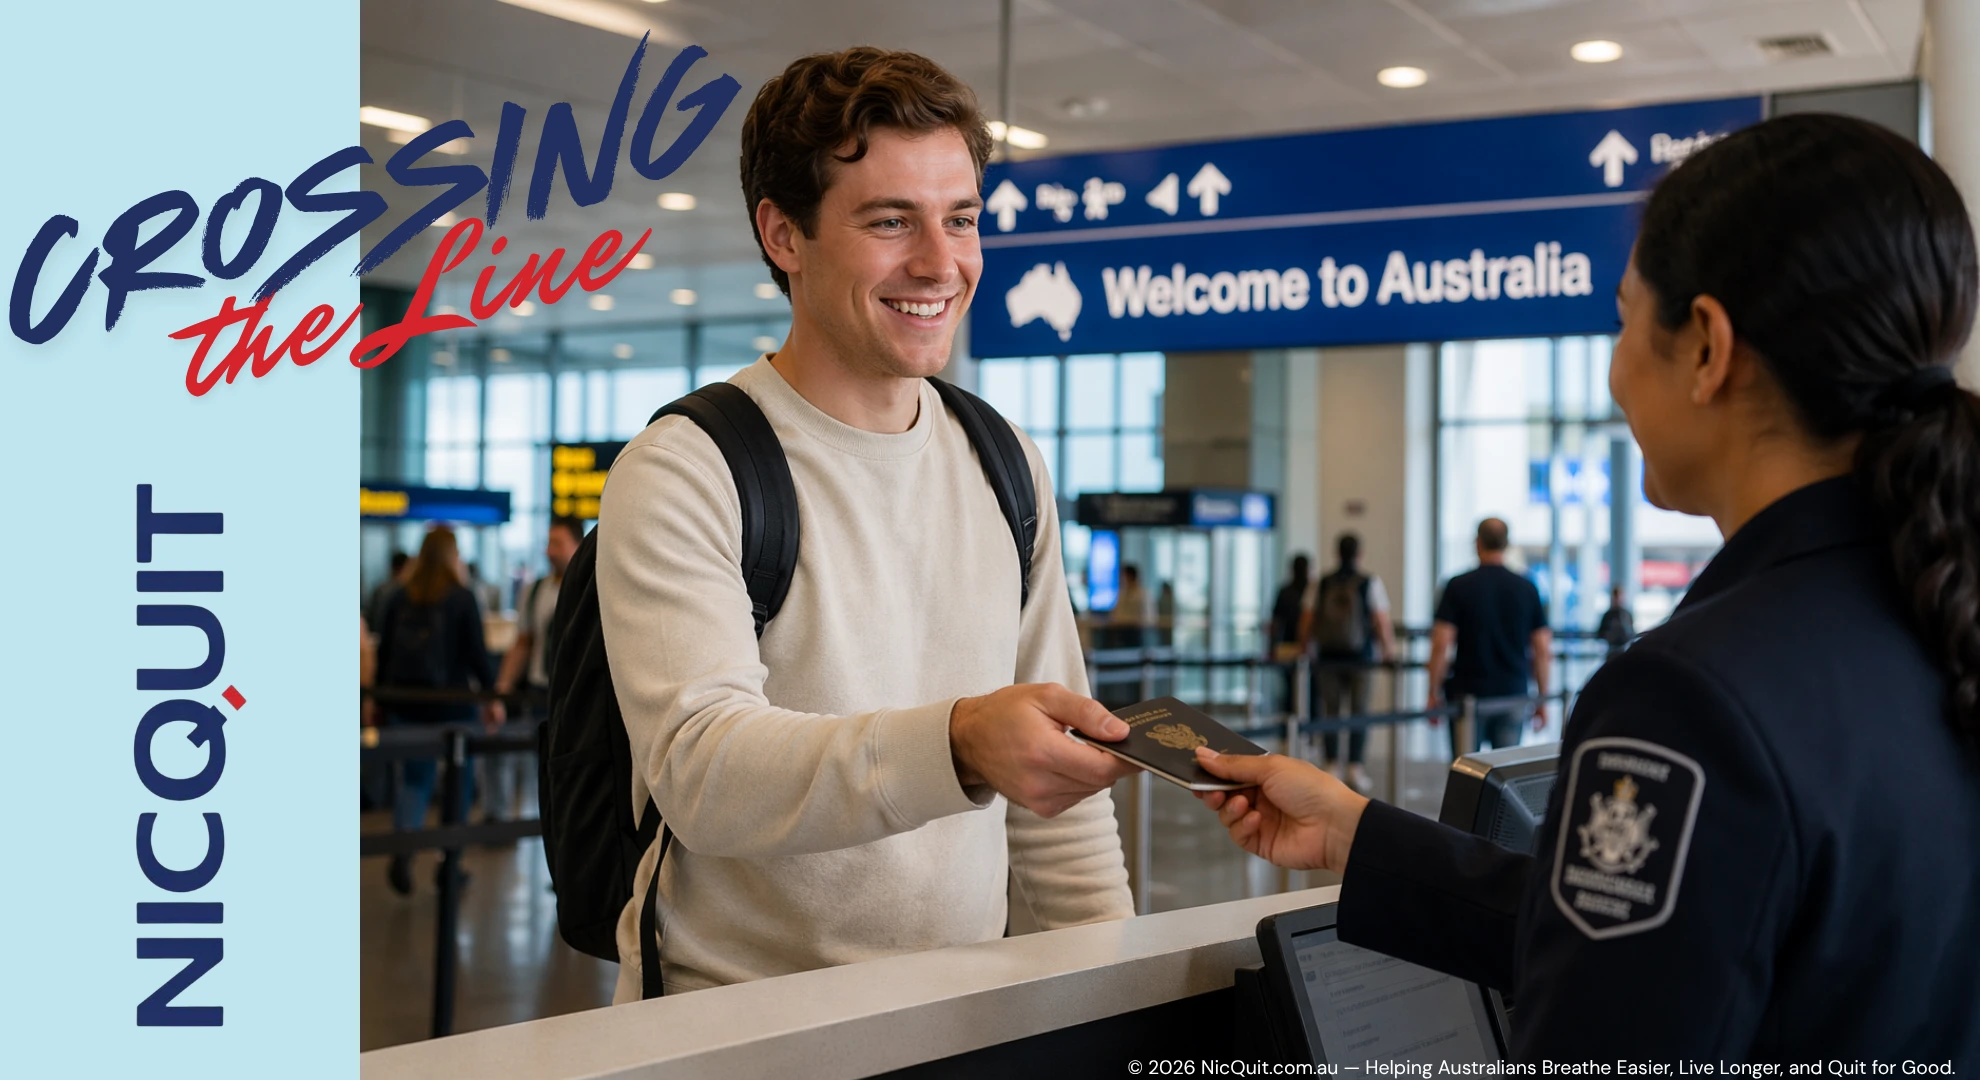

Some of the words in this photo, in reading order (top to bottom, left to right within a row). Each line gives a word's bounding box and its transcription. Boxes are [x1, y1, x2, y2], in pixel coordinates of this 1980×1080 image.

[1102, 262, 1310, 319] Welcome
[1318, 256, 1369, 308] to
[1376, 241, 1594, 306] Australia
